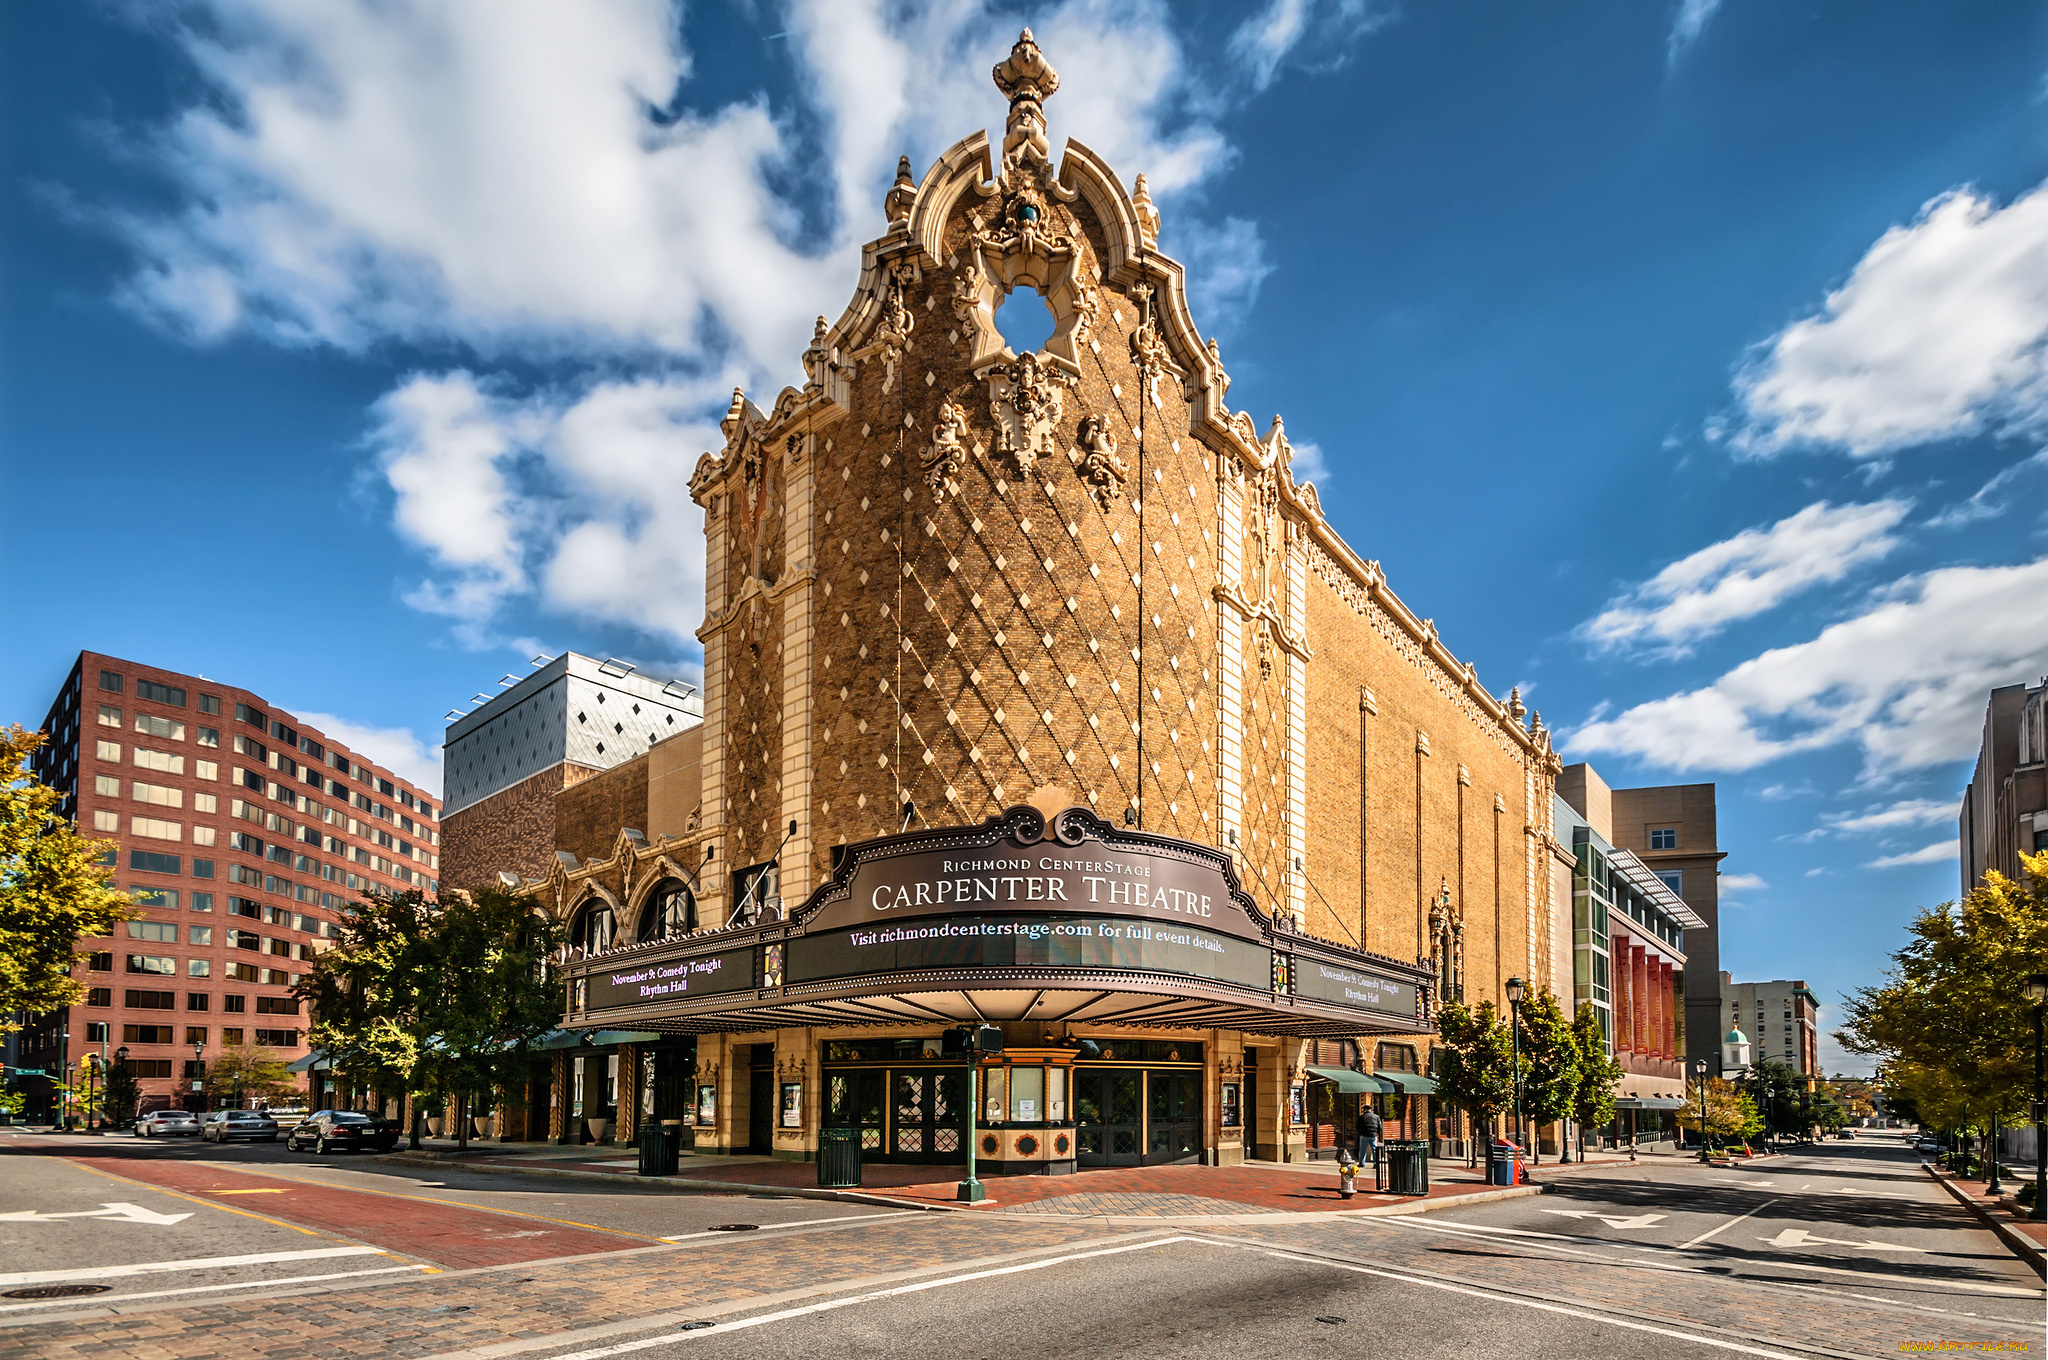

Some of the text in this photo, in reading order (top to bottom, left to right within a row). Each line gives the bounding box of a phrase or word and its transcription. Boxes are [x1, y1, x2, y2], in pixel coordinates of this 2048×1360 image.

[943, 857, 1151, 877] RICHMOND CENTERSTAGE
[871, 876, 1212, 918] CARPENTER THEATRE
[850, 922, 1225, 953] Visit richmondcenterstage.com for full event details.
[611, 971, 648, 986] November
[656, 964, 688, 978] Comedy
[689, 958, 722, 974] Tonight
[1320, 966, 1351, 983] November
[1357, 975, 1379, 992] Comedy
[1380, 980, 1400, 995] Tonight
[640, 980, 687, 999] Rhythm Hall
[1345, 987, 1379, 1004] Rhythm Hall
